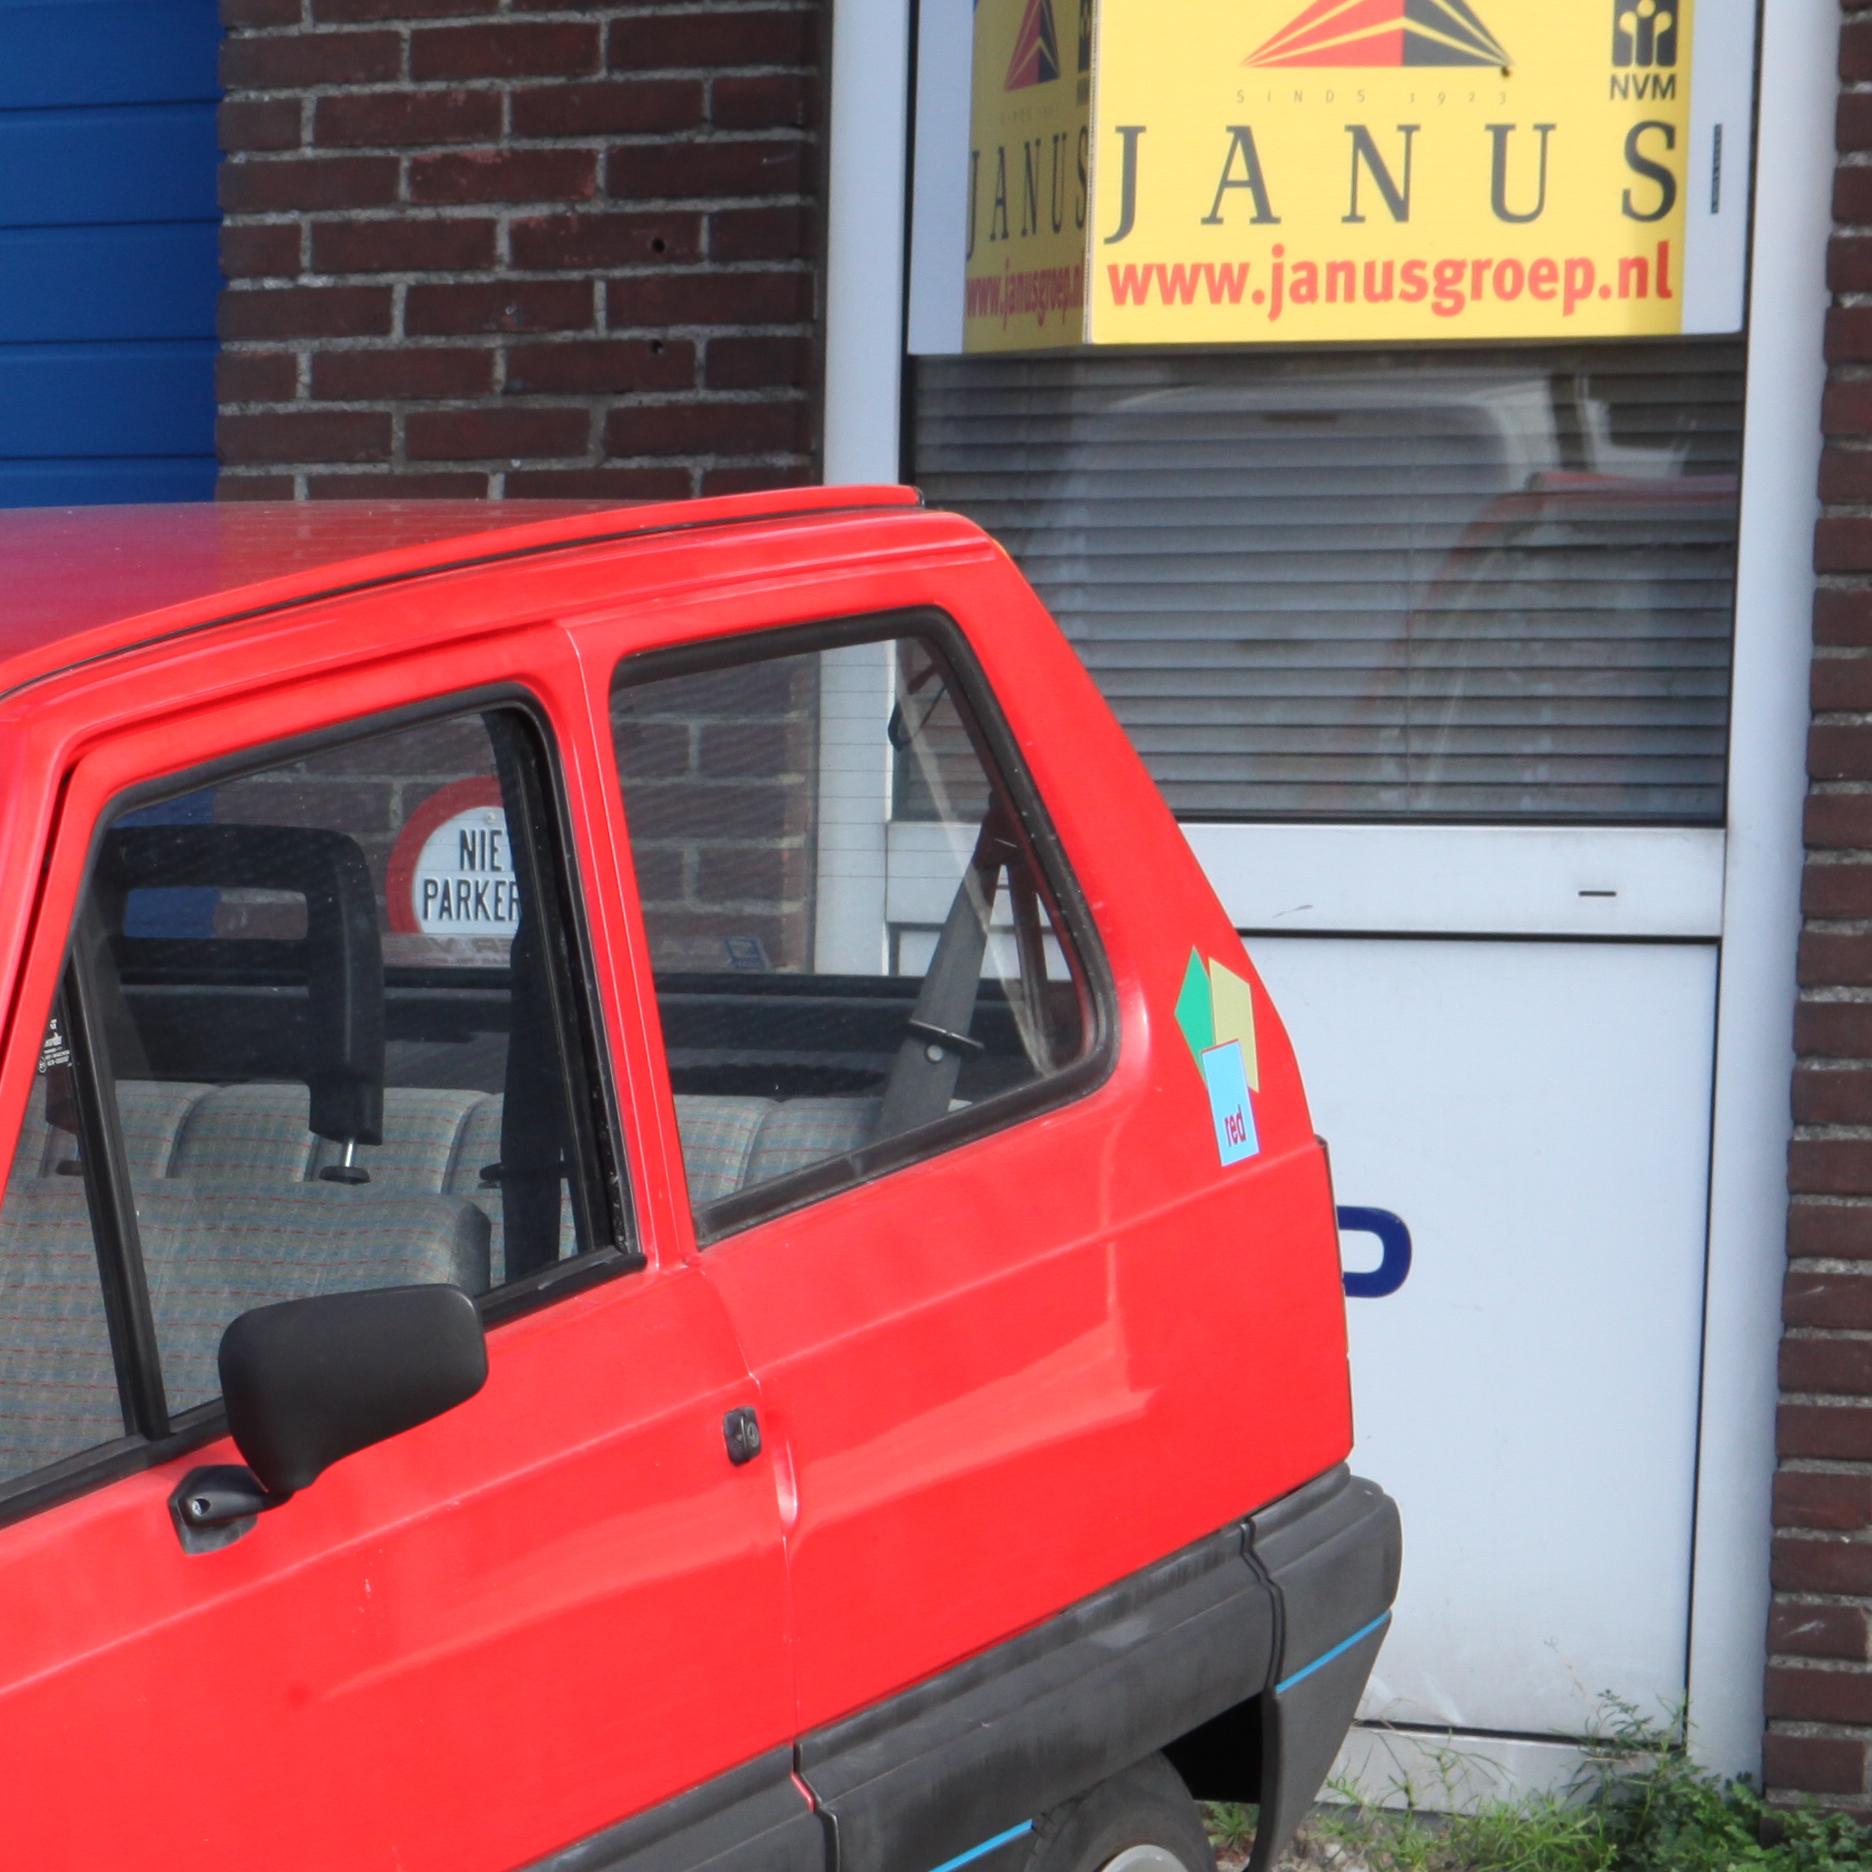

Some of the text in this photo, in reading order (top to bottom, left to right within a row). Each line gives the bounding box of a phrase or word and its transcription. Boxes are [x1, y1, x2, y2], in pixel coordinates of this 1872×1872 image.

[1236, 89, 1506, 106] SINDS 1923
[1610, 73, 1677, 100] NVM
[966, 125, 1089, 262] JANUS
[1103, 119, 1678, 245] JANUS
[1106, 239, 1674, 323] www.janusgroep.nl
[1224, 1103, 1247, 1148] red
